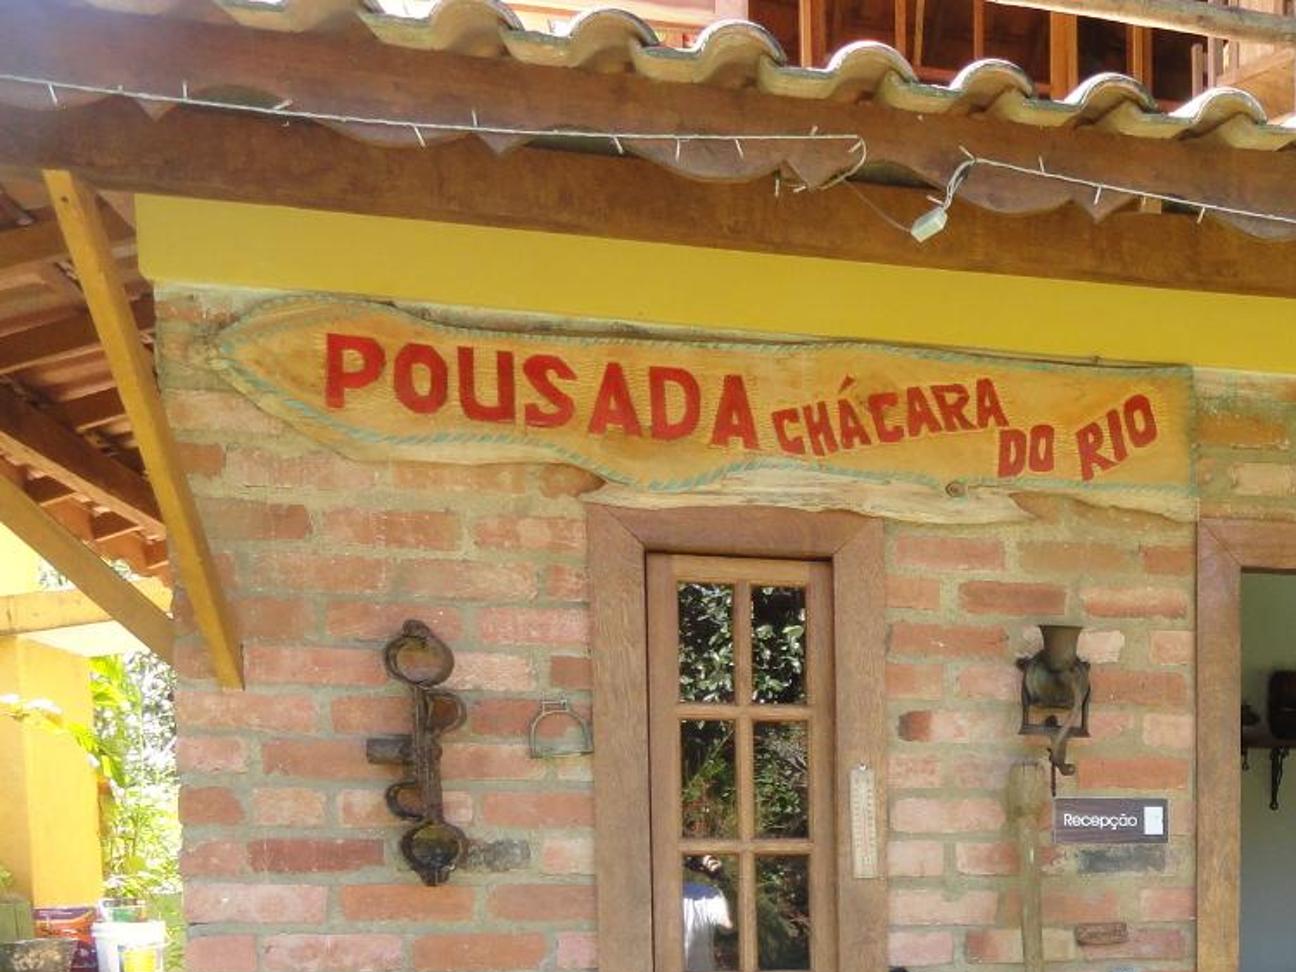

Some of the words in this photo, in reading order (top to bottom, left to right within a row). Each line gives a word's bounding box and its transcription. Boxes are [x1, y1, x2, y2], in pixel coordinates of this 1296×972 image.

[324, 331, 758, 450] POUSADA
[771, 375, 1008, 456] CHÁCARA
[998, 424, 1055, 479] DO
[1076, 394, 1158, 481] RIO
[1063, 813, 1138, 831] Recepção
